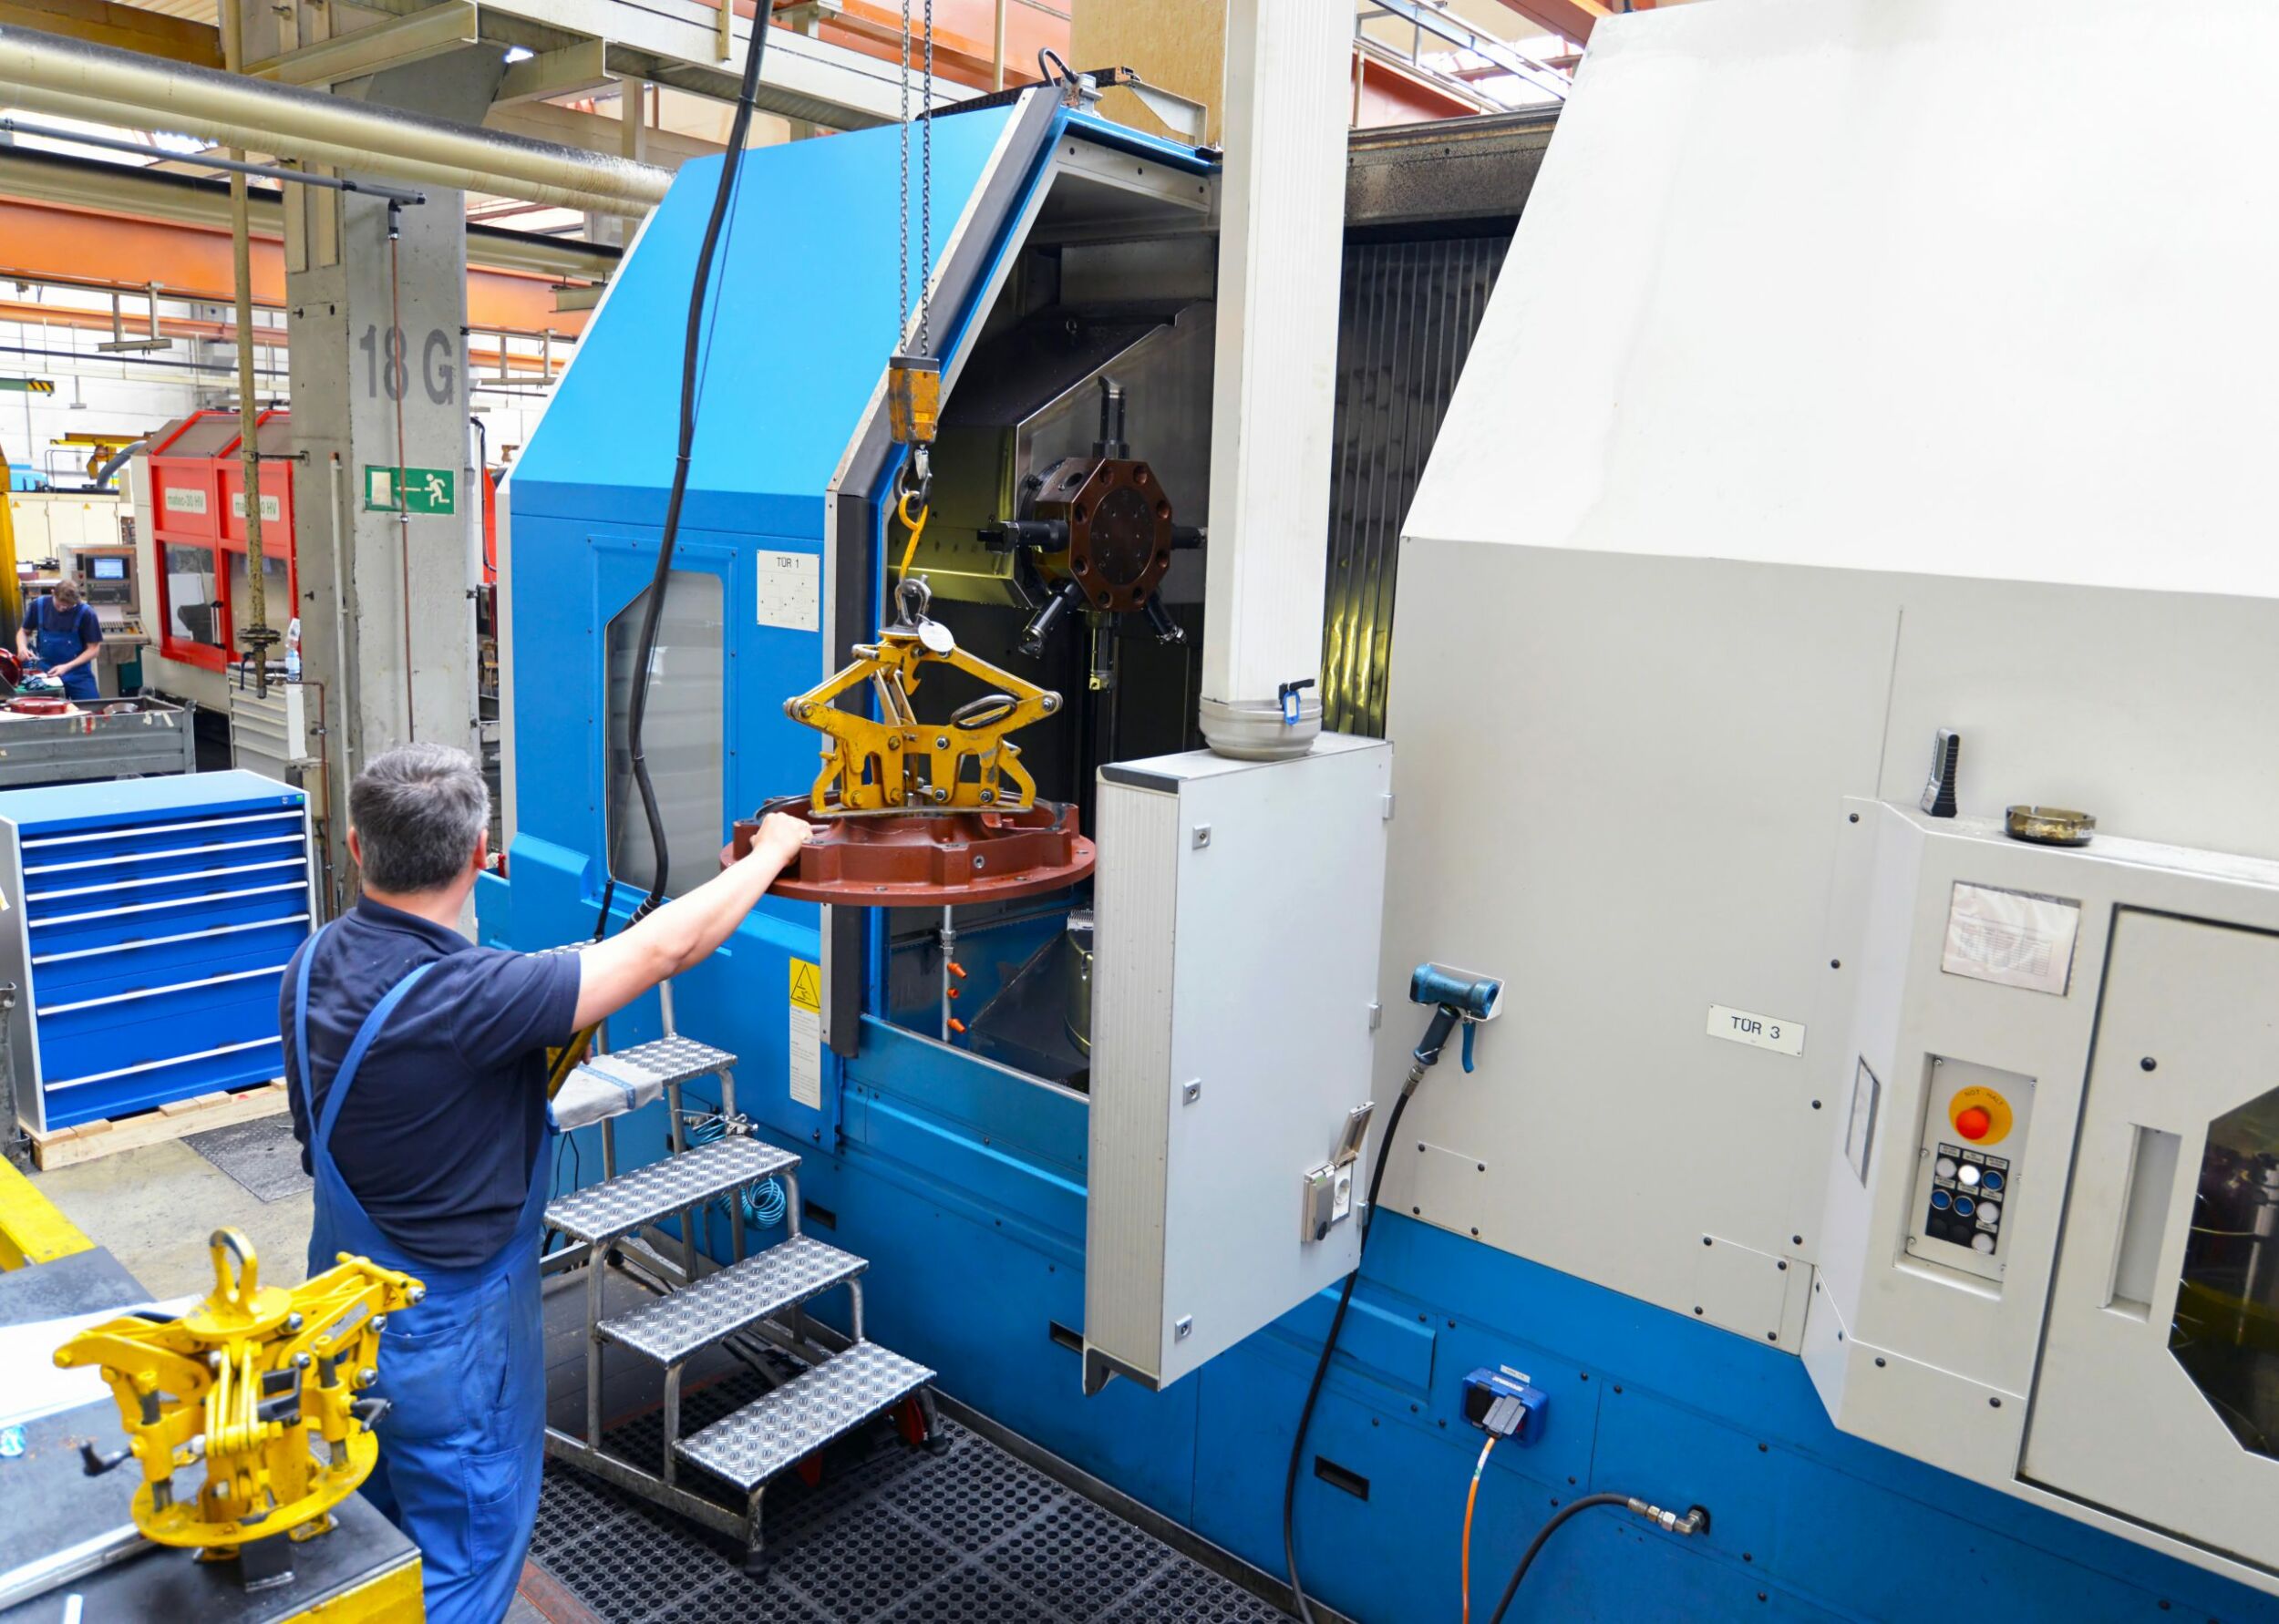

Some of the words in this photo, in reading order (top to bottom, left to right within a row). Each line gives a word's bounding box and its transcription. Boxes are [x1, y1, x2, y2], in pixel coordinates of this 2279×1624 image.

[359, 324, 408, 401] 18
[423, 329, 453, 405] G
[194, 495, 203, 509] HV
[266, 500, 277, 516] HV
[1731, 1016, 1761, 1035] TÜR
[1769, 1025, 1780, 1039] 3
